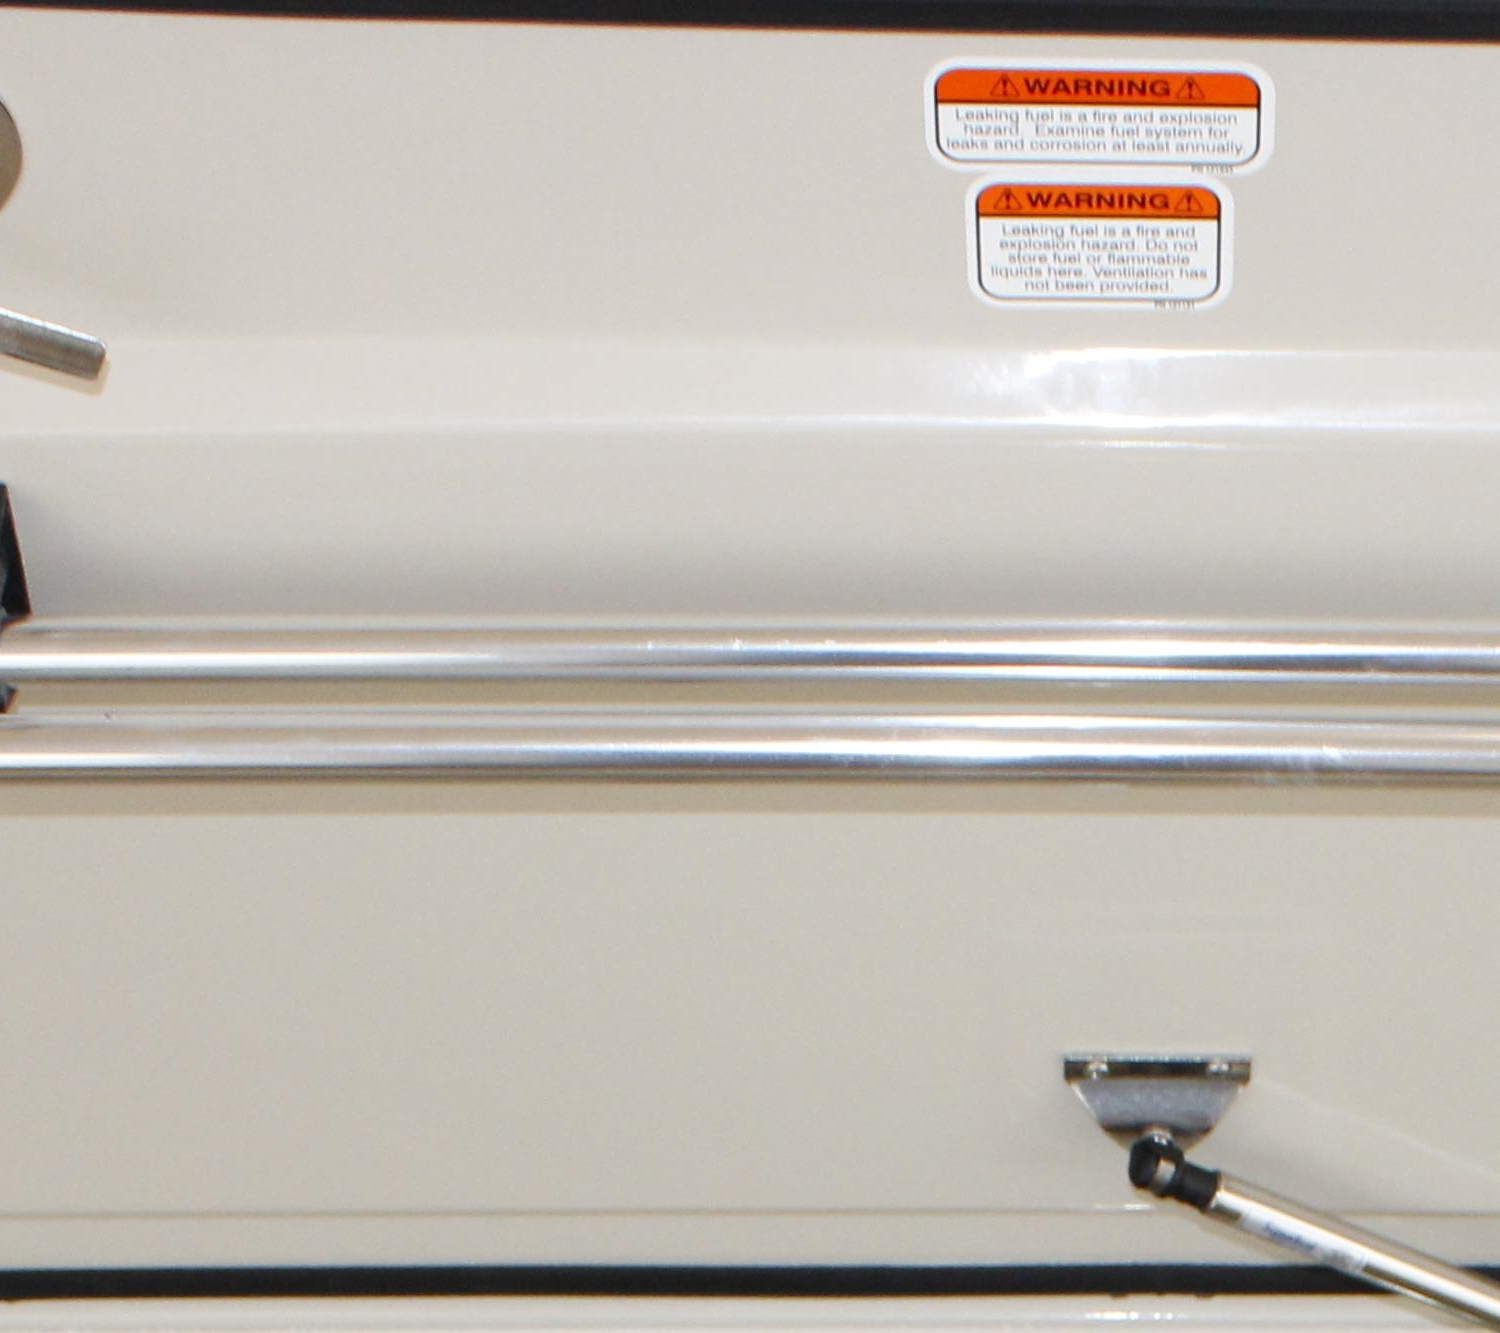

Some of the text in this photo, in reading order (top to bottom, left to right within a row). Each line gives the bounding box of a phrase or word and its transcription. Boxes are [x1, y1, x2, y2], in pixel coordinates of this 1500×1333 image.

[1024, 77, 1171, 98] WARNING
[955, 108, 1238, 127] Leaking fuel is a fire and explosion
[1035, 124, 1106, 137] Examine
[1111, 125, 1140, 137] fuel
[1145, 127, 1203, 140] system
[1208, 126, 1230, 139] for
[946, 138, 989, 150] leaks
[994, 138, 1025, 150] and
[1029, 139, 1107, 151] corrosion
[1112, 140, 1127, 152] at
[1132, 140, 1170, 152] least
[1026, 192, 1171, 210] WARNING
[1002, 223, 1196, 239] Leaking fuel is a fire and
[1000, 239, 1076, 253] explosion
[1145, 239, 1168, 252] Do
[1172, 240, 1199, 252] not
[1008, 252, 1190, 266] store fuel or flammable
[991, 266, 1043, 280] liquids
[1093, 267, 1175, 279] Ventilation
[1179, 267, 1208, 279] has
[1025, 279, 1050, 291] not
[1055, 279, 1094, 292] been
